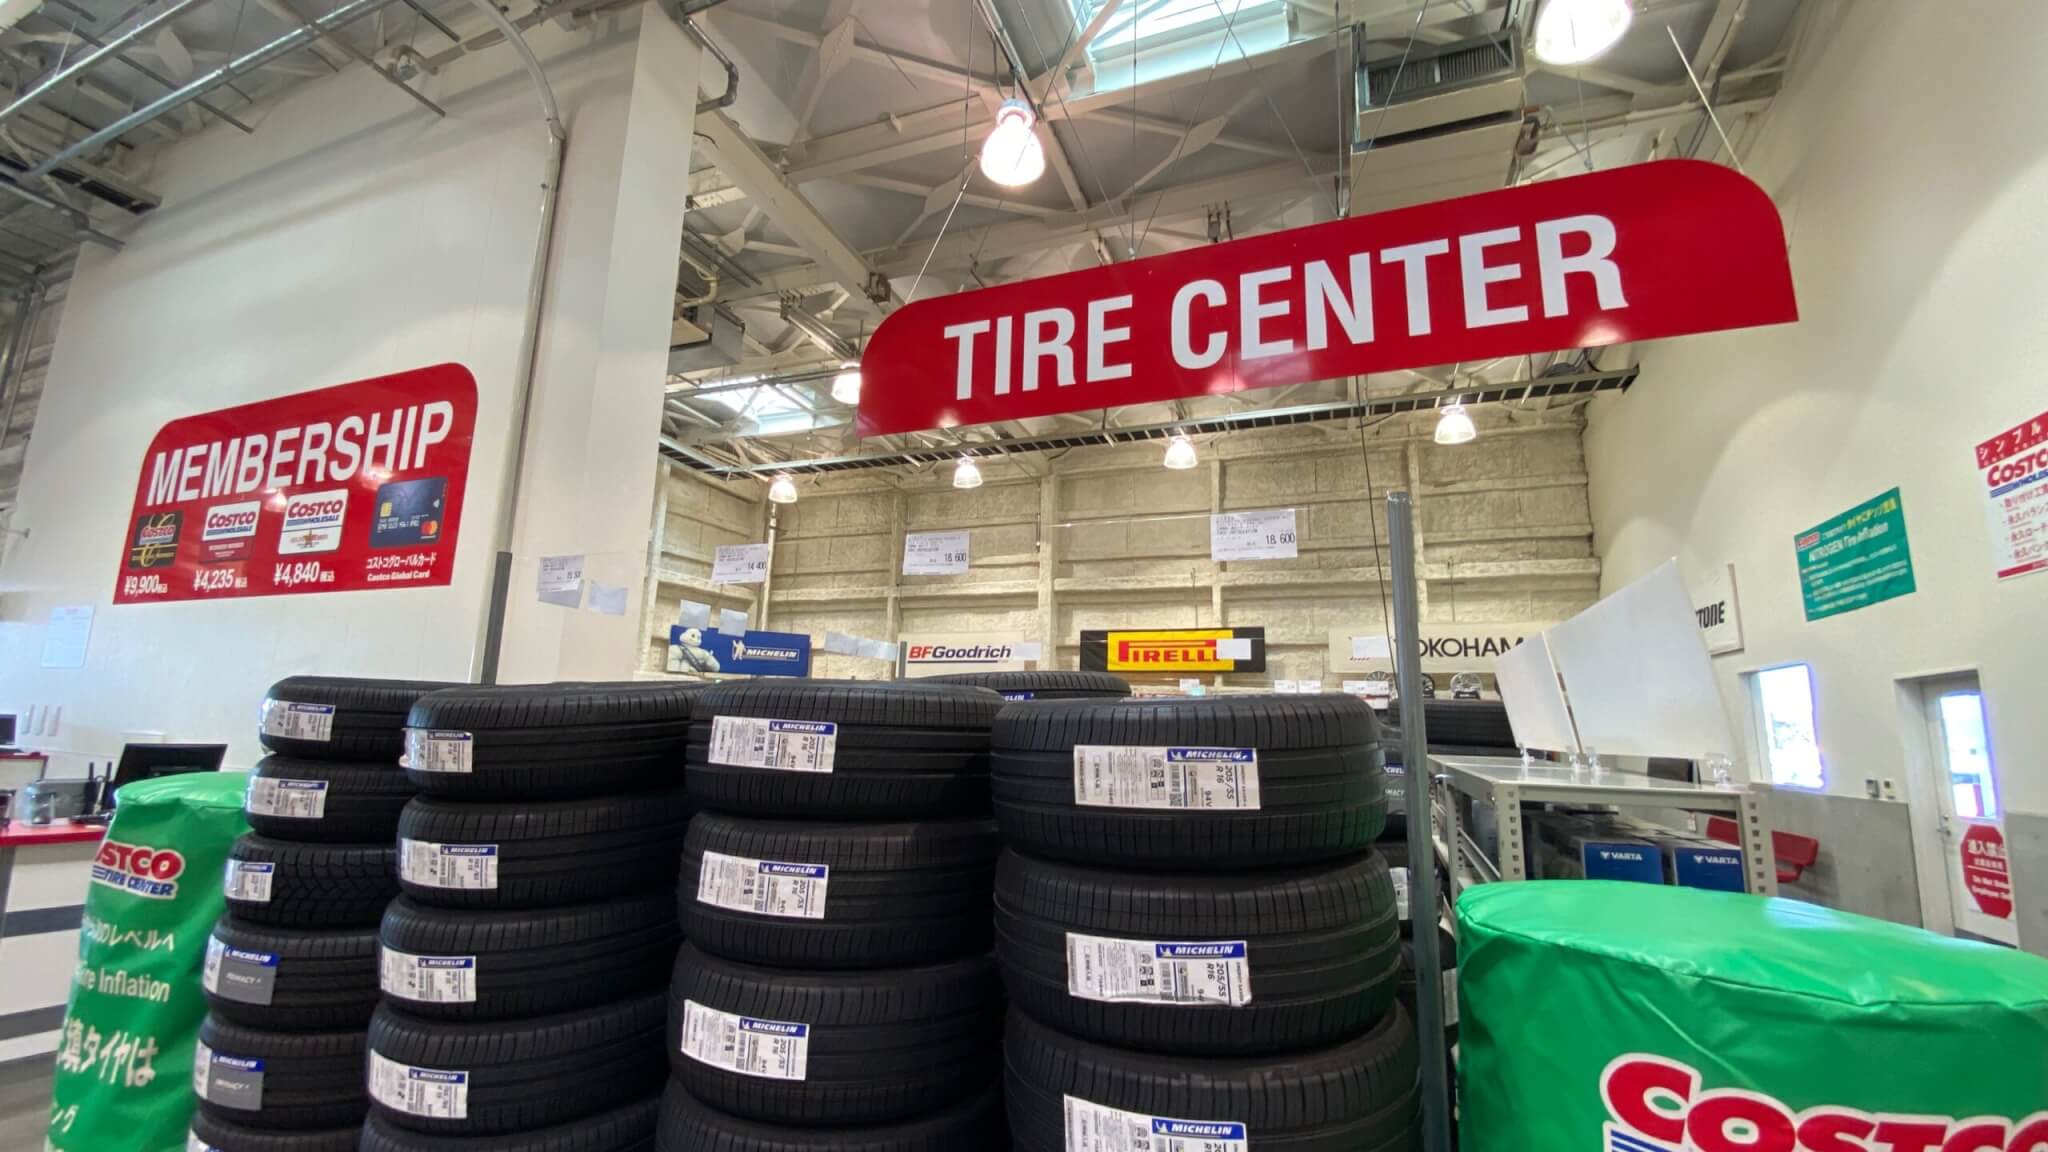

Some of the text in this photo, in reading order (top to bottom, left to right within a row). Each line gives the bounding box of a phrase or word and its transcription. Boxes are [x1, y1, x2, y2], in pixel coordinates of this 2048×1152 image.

[944, 213, 1630, 401] TIRE CENTER
[146, 400, 454, 507] MEMBERSHIP
[1987, 447, 2048, 487] COSTC
[288, 500, 343, 519] COSTCO
[208, 512, 256, 529] COSTCO
[273, 561, 321, 588] ¥4,840
[1695, 600, 1725, 629] TONE
[746, 649, 798, 659] MICHELIN
[908, 645, 1011, 659] BFGoodrich
[1419, 637, 1524, 657] KOHAM
[1186, 750, 1244, 761] MICHELIN
[97, 841, 182, 881] STCO
[1611, 851, 1643, 861] VARTA
[1705, 855, 1739, 865] VARTA
[772, 863, 817, 875] MICHELIN
[127, 877, 175, 897] CENTER
[1175, 945, 1235, 956] MICHELIN
[98, 967, 171, 1004] Inflation
[752, 1022, 799, 1034] MICHELIN
[1171, 1123, 1233, 1136] MICHELIN
